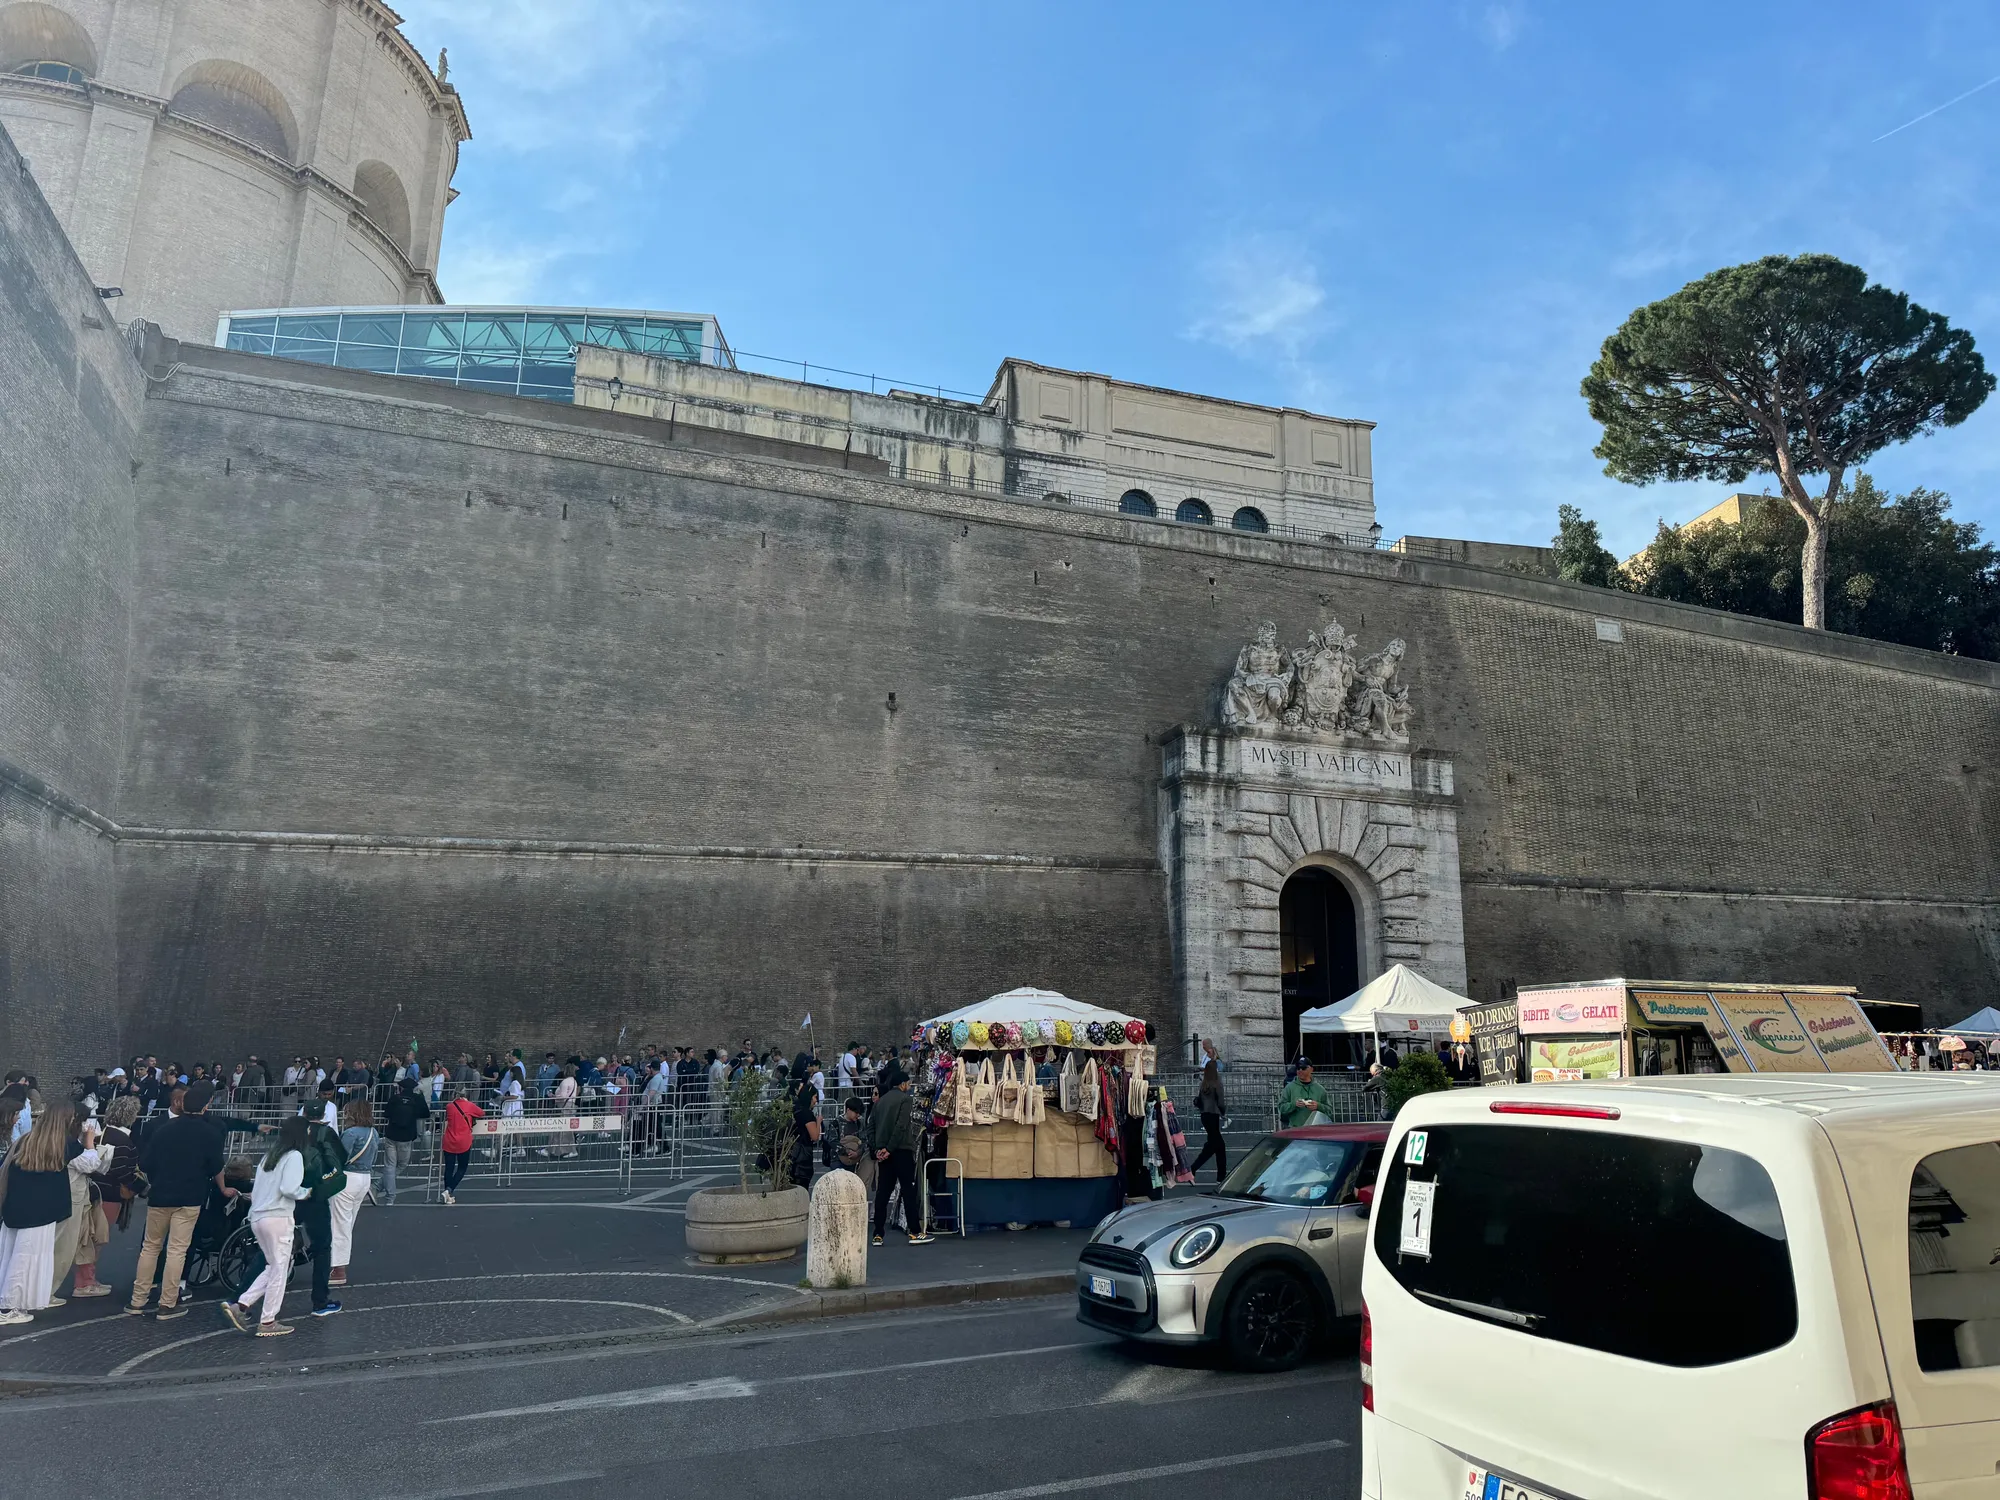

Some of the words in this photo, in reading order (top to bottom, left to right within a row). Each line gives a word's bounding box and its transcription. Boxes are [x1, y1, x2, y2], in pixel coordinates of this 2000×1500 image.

[1251, 746, 1308, 768] MVSEI
[1316, 753, 1402, 777] VATICANI
[1485, 1004, 1516, 1026] DRINKS
[1523, 1009, 1550, 1022] BIBITE
[1582, 1005, 1618, 1019] GELATI
[1478, 1036, 1491, 1053] ICE
[1482, 1054, 1517, 1076] HELDO
[501, 1119, 526, 1127] MVSEI
[529, 1118, 567, 1126] VATICANI
[1409, 1134, 1425, 1161] 12
[1412, 1207, 1421, 1238] 1
